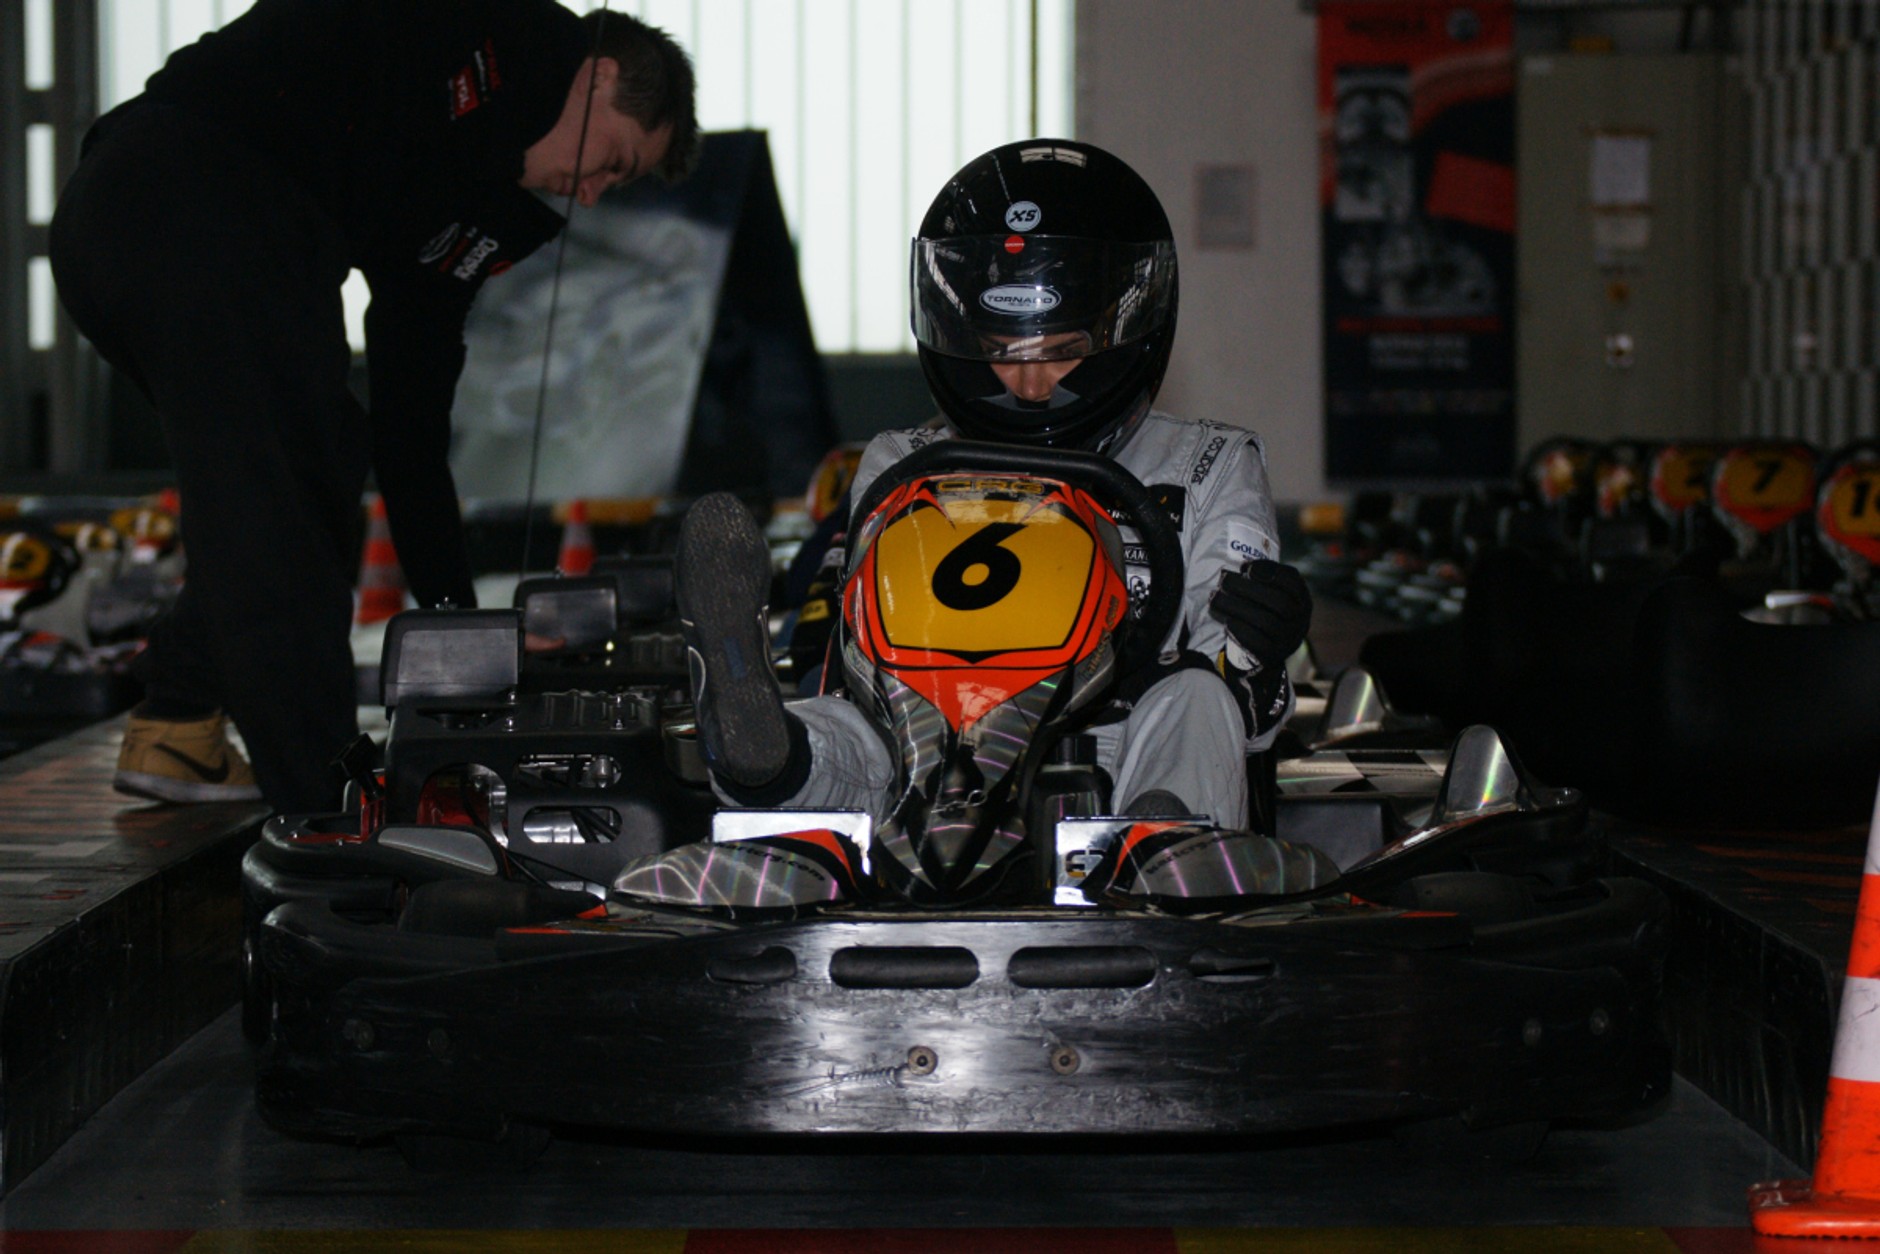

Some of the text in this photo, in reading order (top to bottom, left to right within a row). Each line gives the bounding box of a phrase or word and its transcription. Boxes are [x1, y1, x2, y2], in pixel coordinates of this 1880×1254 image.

[986, 295, 1053, 304] TORNAO
[1190, 435, 1226, 485] sparco
[1755, 461, 1781, 492] 7
[931, 521, 1029, 611] 6
